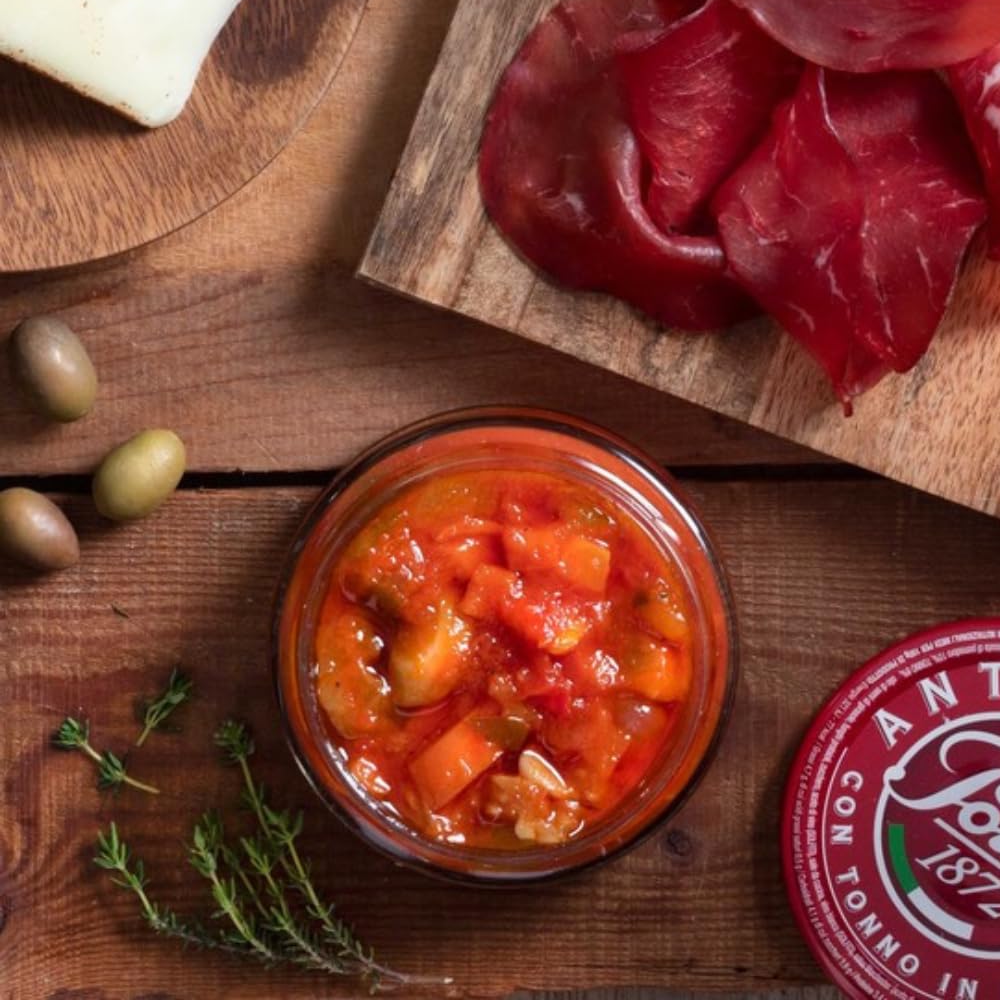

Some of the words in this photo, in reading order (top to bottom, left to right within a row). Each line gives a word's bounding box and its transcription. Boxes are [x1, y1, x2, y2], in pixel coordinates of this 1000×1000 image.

[831, 770, 865, 846] CON
[836, 865, 921, 976] TONNO
[938, 972, 979, 1000] IN
